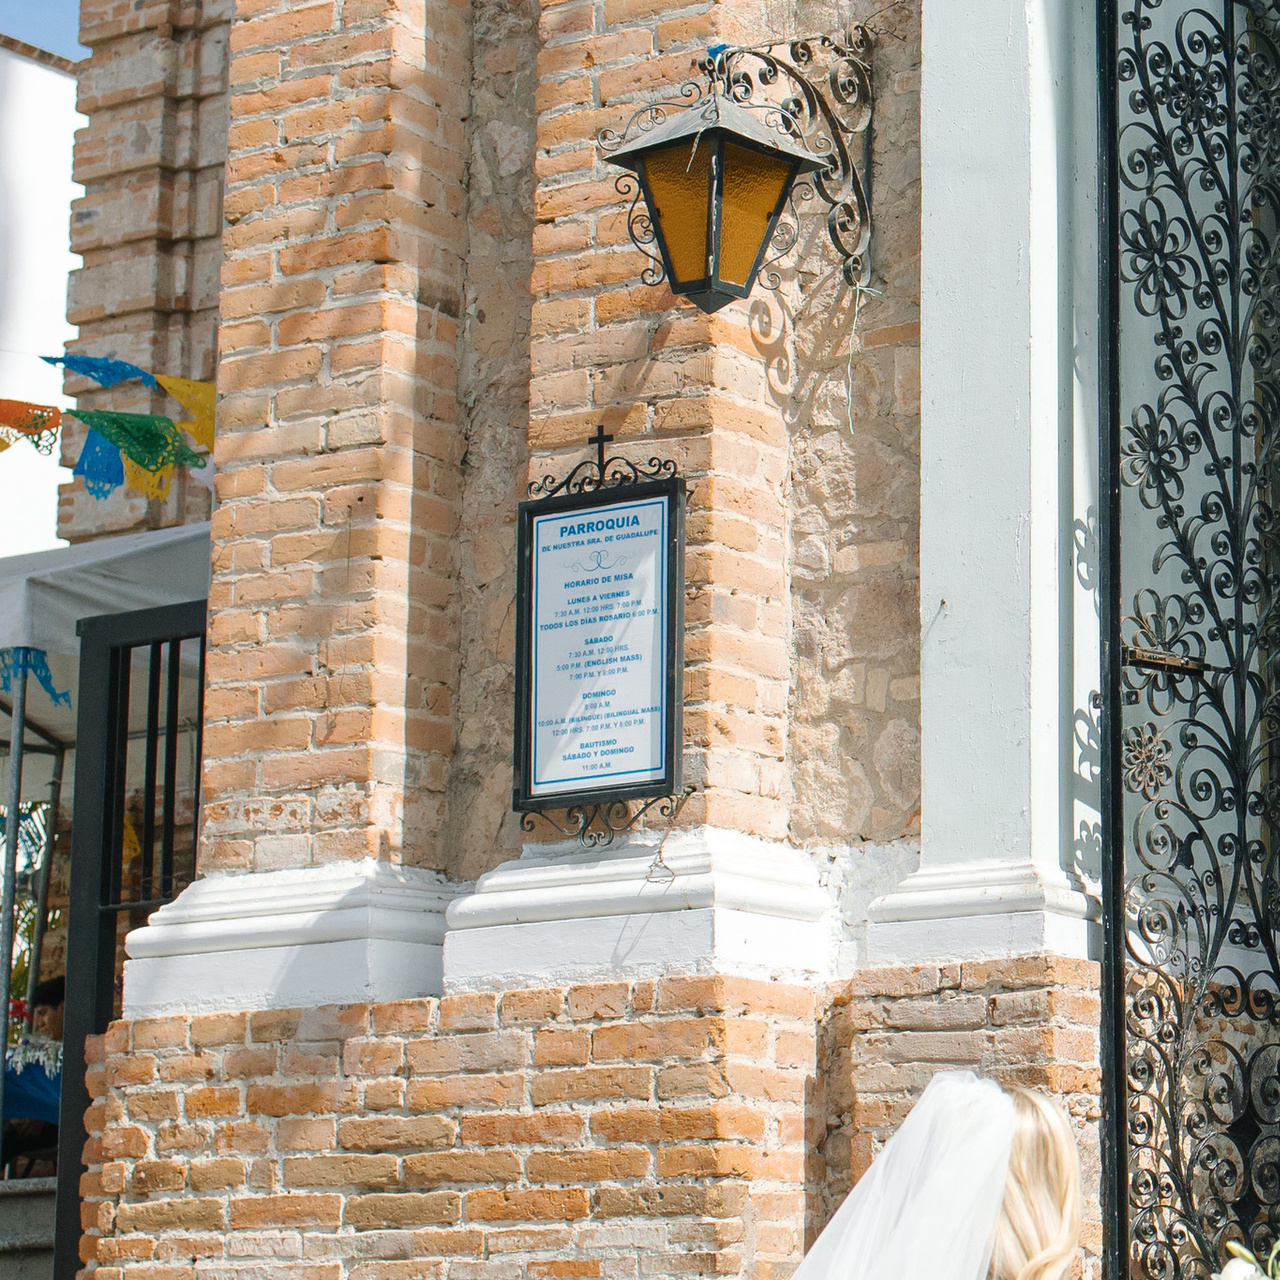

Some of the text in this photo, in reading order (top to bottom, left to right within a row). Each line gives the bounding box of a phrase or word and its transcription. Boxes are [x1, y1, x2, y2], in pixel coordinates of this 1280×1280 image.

[560, 515, 640, 537] PARROQUIA
[541, 545, 551, 553] DE
[552, 540, 585, 551] NUESTRA
[587, 537, 602, 546] SRA.
[616, 529, 659, 541] GUADALUPE
[564, 573, 634, 589] HORARIO DE MISA
[567, 596, 591, 605] LUNES
[599, 590, 630, 600] VIERNES
[583, 605, 599, 614] 12:00
[540, 622, 563, 631] TODOS
[599, 612, 631, 623] ROSARIO
[584, 657, 618, 669] (ENGLISH
[619, 653, 643, 663] MASS)
[582, 689, 616, 700] DOMINGO
[603, 709, 640, 720] (BILINGUAL
[641, 705, 661, 713] MASS)
[580, 738, 617, 749] BAUTISMO
[600, 746, 635, 757] DOMINGO
